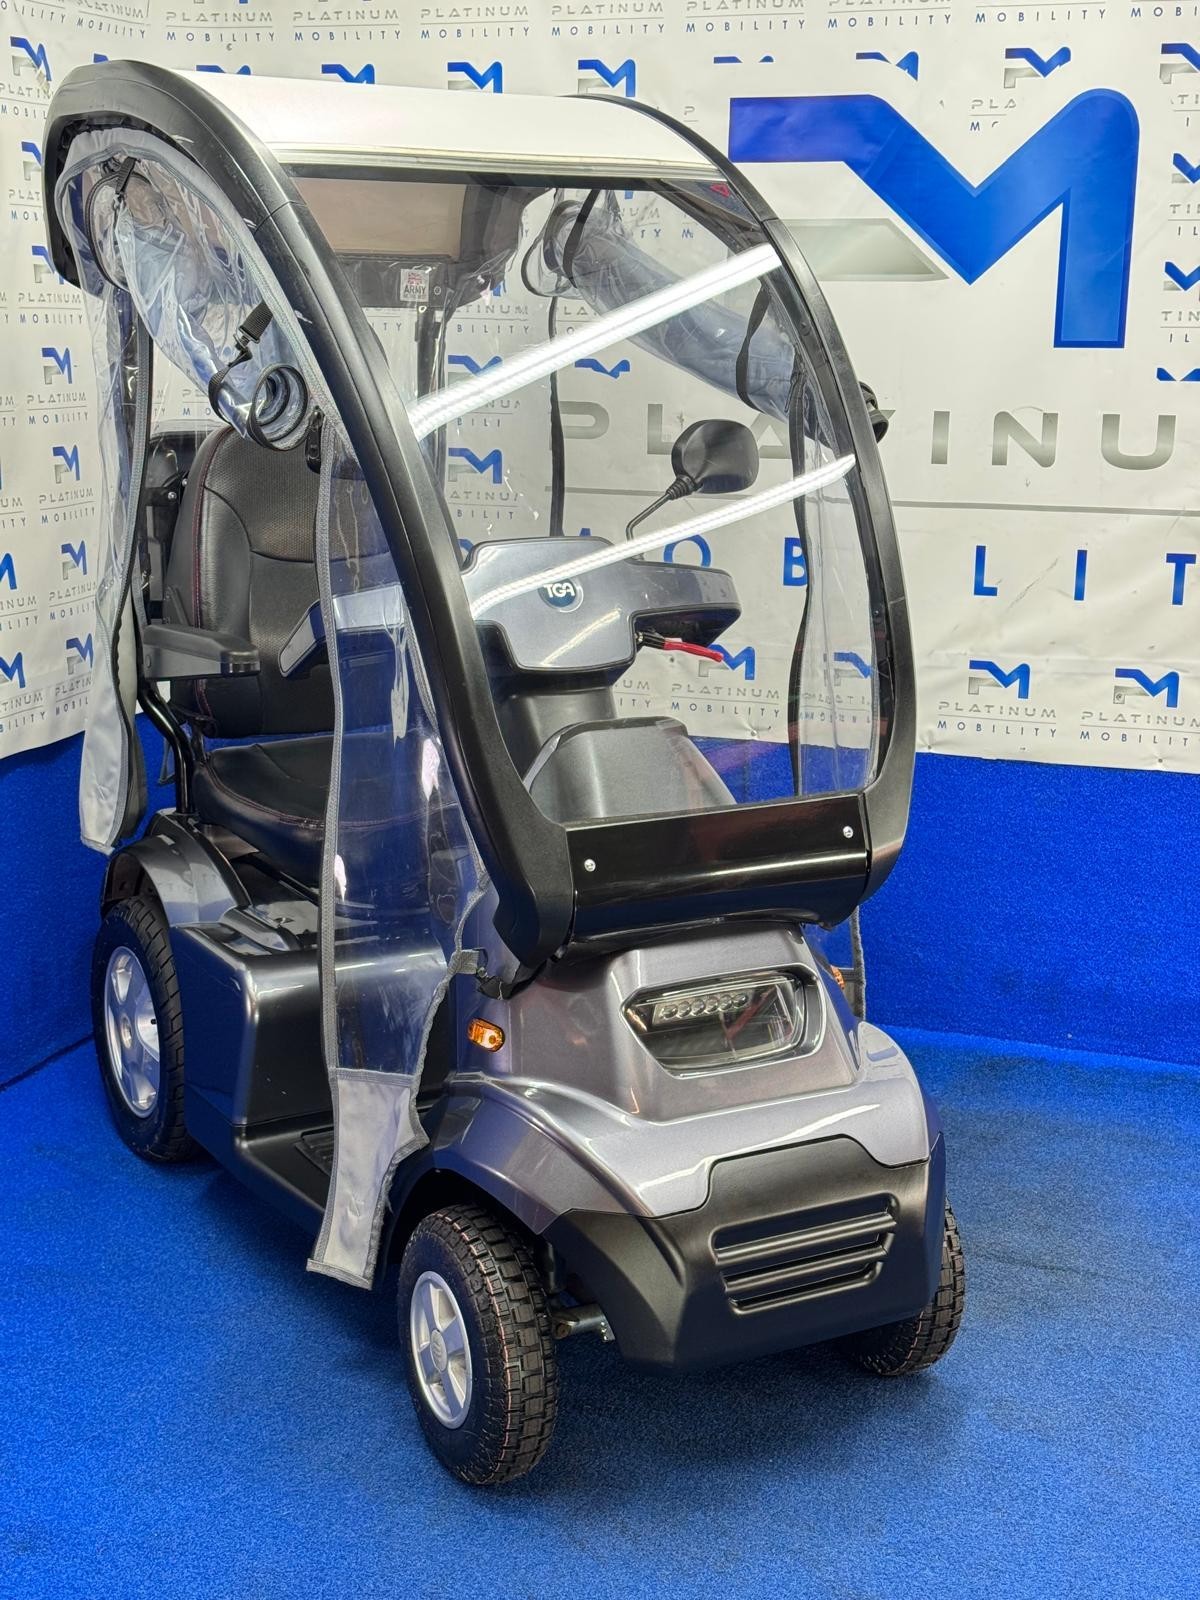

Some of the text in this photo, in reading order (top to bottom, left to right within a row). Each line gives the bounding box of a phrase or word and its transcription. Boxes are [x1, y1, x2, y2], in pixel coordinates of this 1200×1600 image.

[293, 9, 399, 21] PLATINUM
[421, 6, 528, 18] PLATINUM
[552, 2, 663, 15] PLATINUM
[166, 11, 272, 22] PLATINUM
[828, 14, 951, 28] MOBILITY
[976, 9, 1107, 23] MOBILITY
[77, 18, 145, 38] MOBILITY
[421, 26, 529, 38] MOBILITY
[552, 24, 664, 36] MOBILITY
[686, 19, 805, 32] MOBILITY
[167, 32, 276, 42] MOBILITY
[295, 30, 400, 41] MOBILITY
[404, 284, 426, 294] ARMY
[18, 292, 81, 304] PLATINUM
[19, 313, 83, 324] MOBILITY
[27, 395, 87, 405] PLATINUM
[28, 411, 89, 425] MOBILITY
[39, 487, 94, 504] PLATINUM
[41, 507, 95, 524] MOBILITY
[543, 582, 576, 598] TGA
[671, 683, 781, 700] PLATINUM
[671, 702, 780, 718] MOBILITY
[938, 701, 1057, 718] PLATINUM
[937, 720, 1057, 738] MOBILITY
